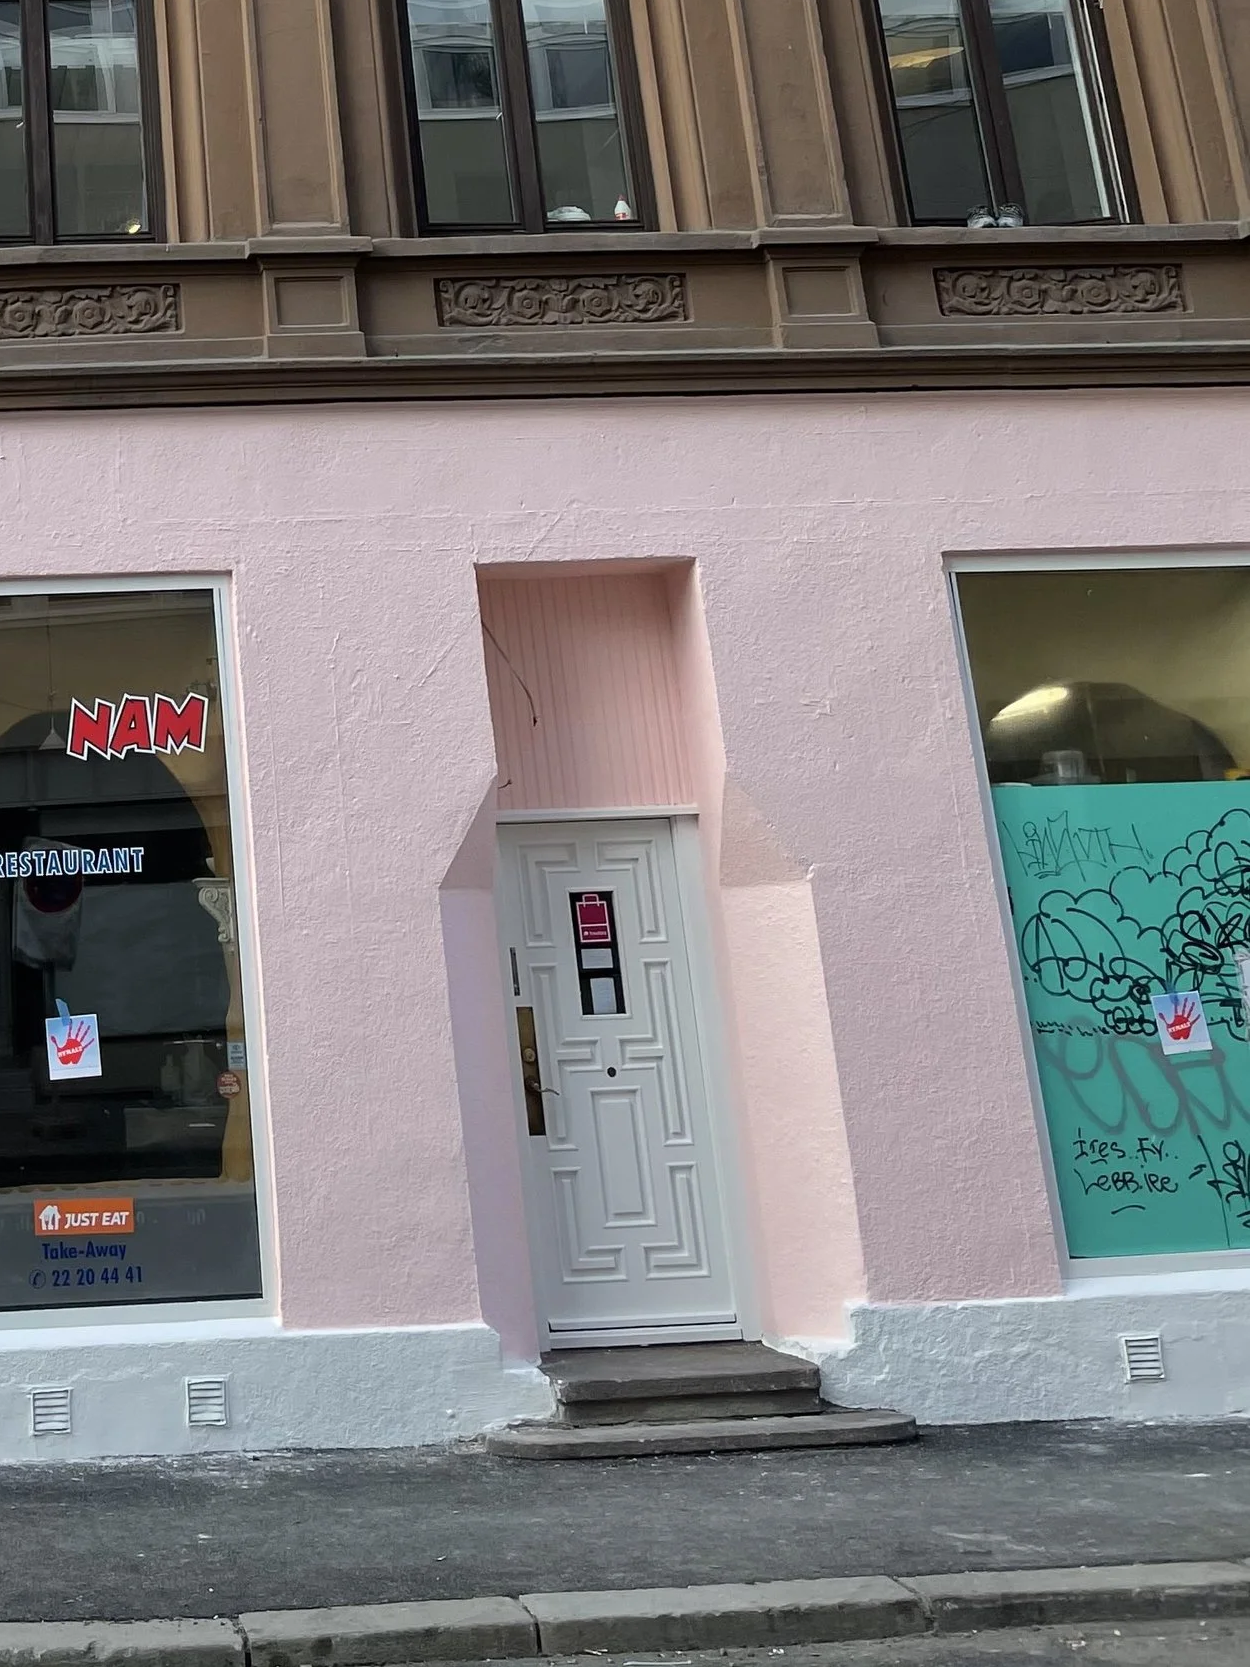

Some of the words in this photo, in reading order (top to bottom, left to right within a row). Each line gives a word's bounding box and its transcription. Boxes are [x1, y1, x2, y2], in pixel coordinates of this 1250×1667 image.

[66, 692, 209, 761] NAM
[64, 1212, 99, 1229] JUST
[102, 1211, 130, 1226] EAT
[42, 1241, 127, 1261] Take-Away
[52, 1269, 71, 1287] 22
[76, 1268, 95, 1286] 20
[100, 1267, 119, 1284] 44
[125, 1265, 142, 1283] 41
